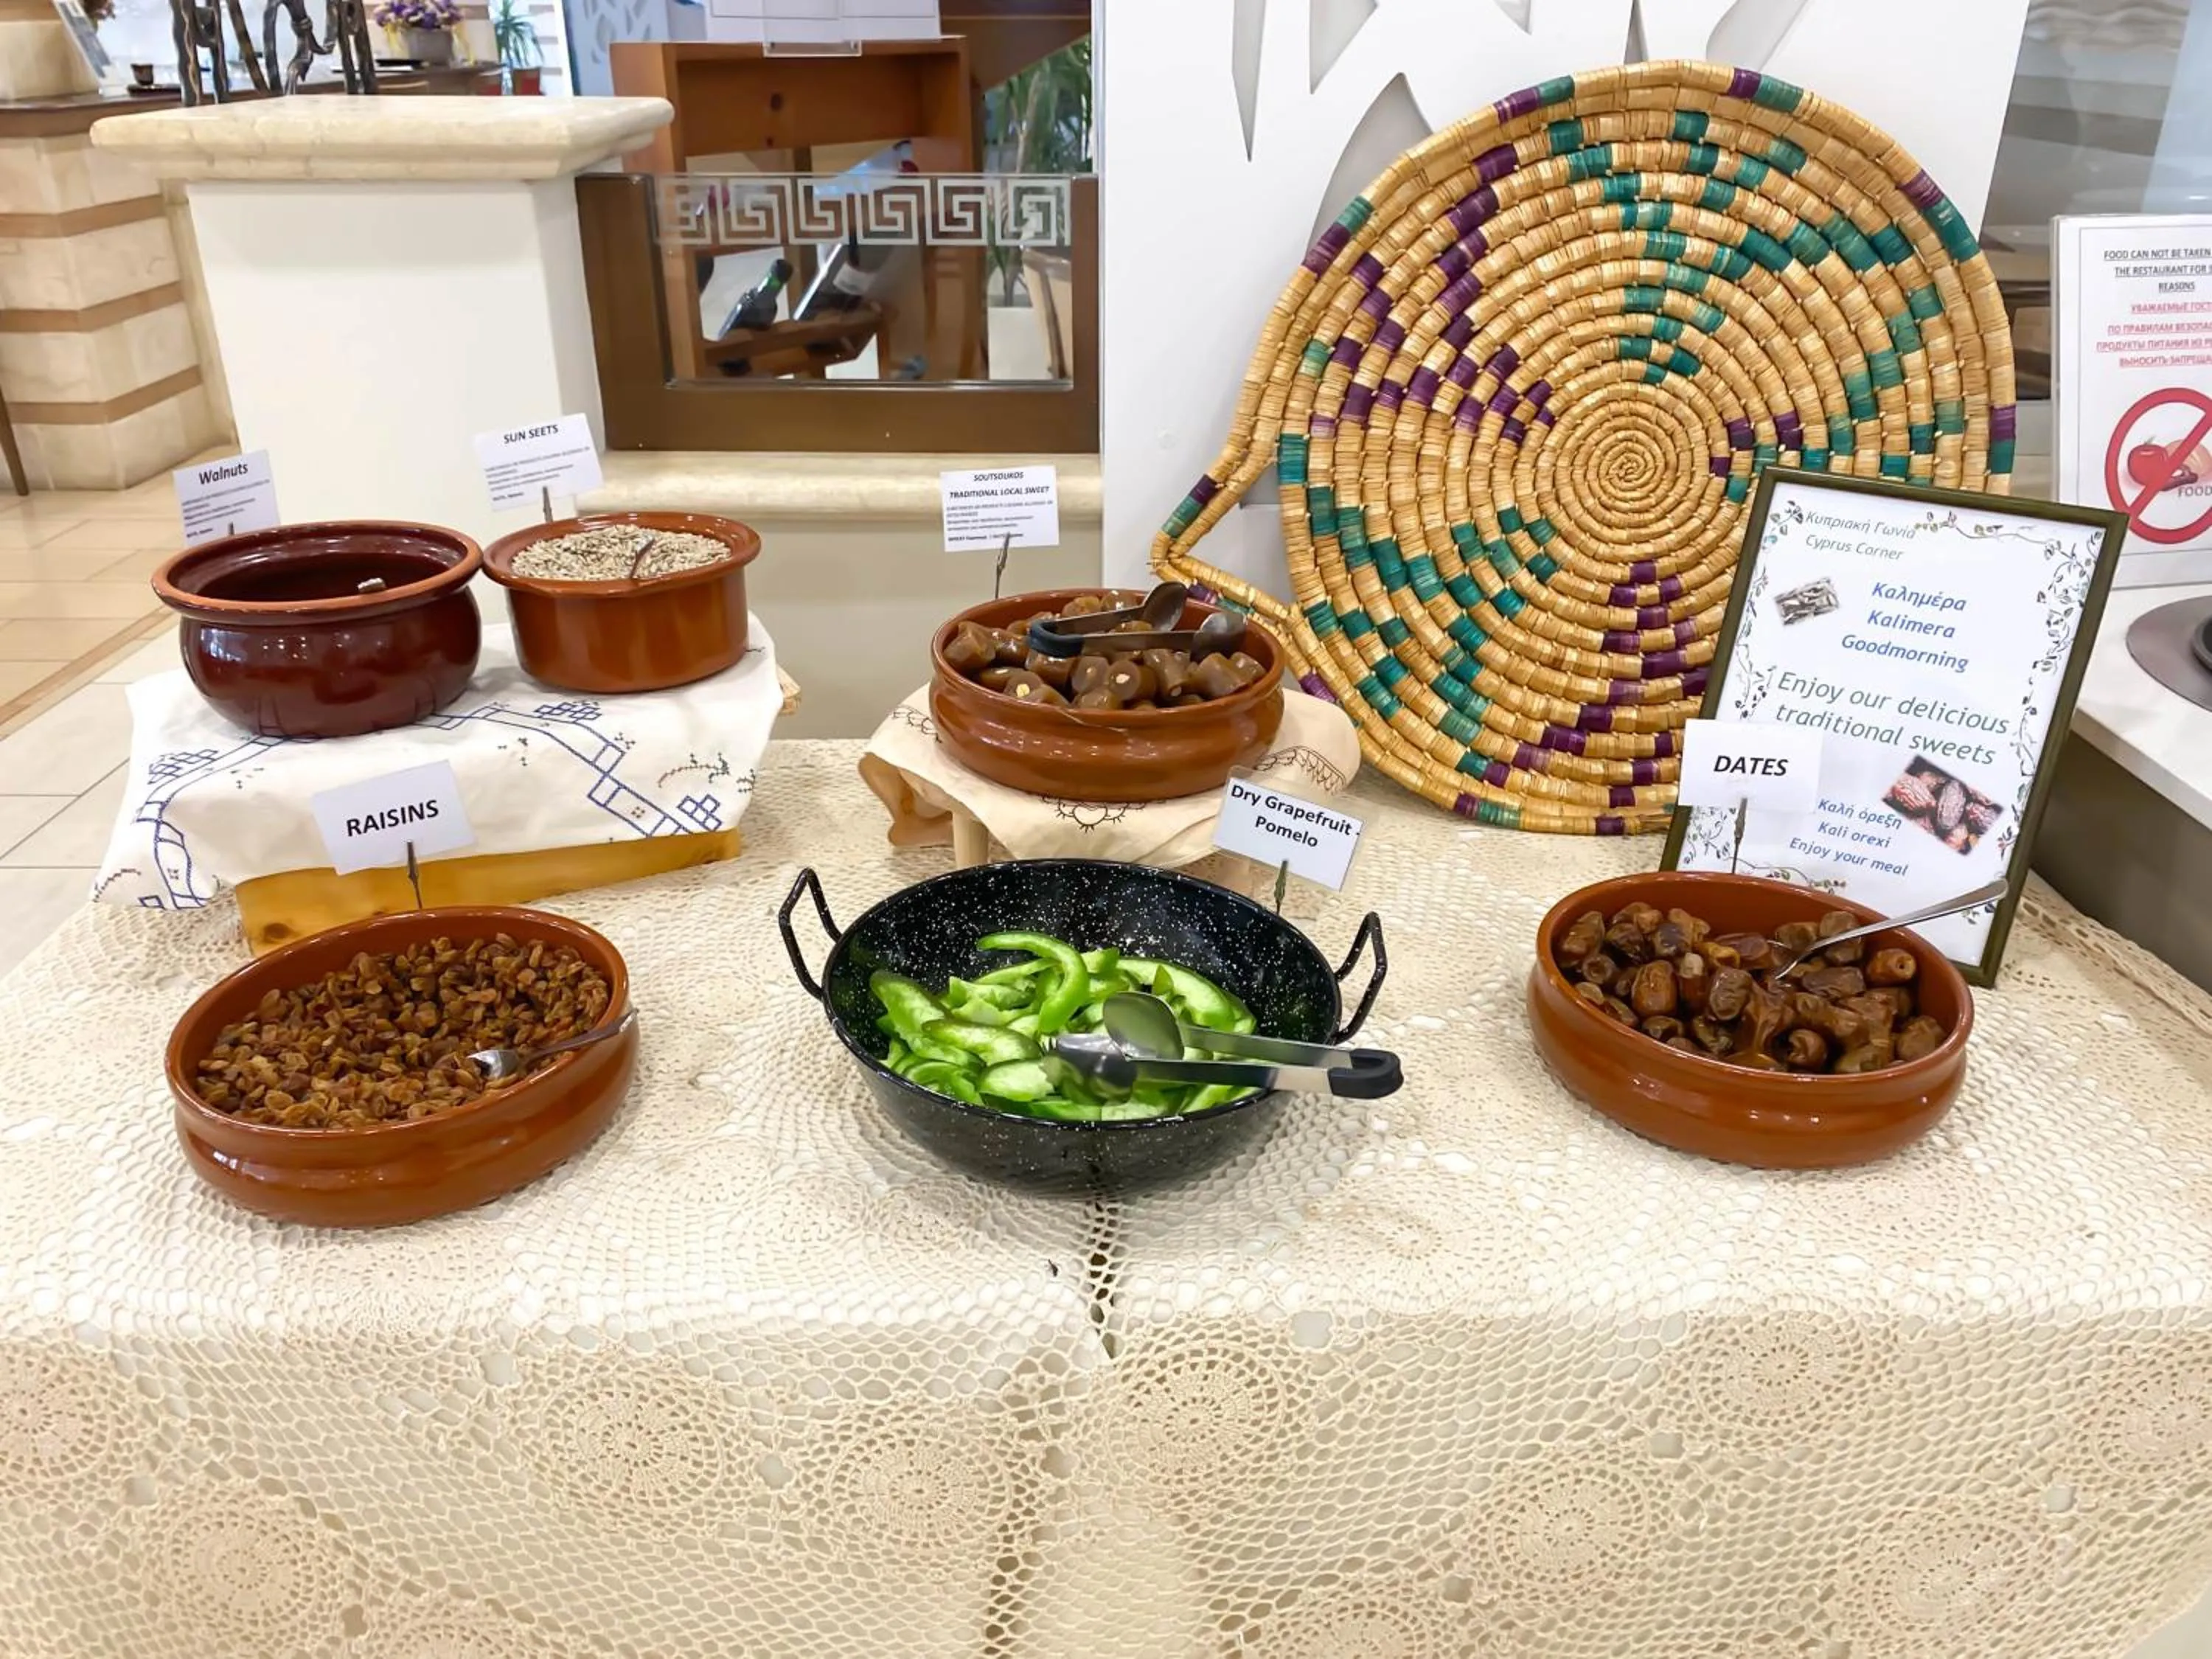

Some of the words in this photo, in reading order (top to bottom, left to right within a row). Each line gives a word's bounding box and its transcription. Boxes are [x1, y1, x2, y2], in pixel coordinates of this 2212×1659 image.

[2104, 250, 2129, 259] FOOD
[2130, 250, 2149, 259] CAN
[2151, 249, 2169, 258] NOT
[2171, 248, 2183, 257] BE
[2183, 248, 2211, 257] TAKEN
[2115, 266, 2130, 275] THE
[2132, 265, 2188, 274] RESTAURANT
[2190, 265, 2207, 274] FOR
[2158, 282, 2195, 291] REASONS
[503, 430, 526, 444] SUN
[529, 424, 559, 439] SEETS
[198, 464, 248, 485] Walnuts
[950, 488, 998, 498] TRADITIONAL
[1001, 487, 1023, 496] LOCAL
[1024, 485, 1050, 494] SWEET
[1806, 510, 1871, 533] Κυπριακή
[1806, 534, 1852, 552] Cyprus
[1855, 542, 1904, 560] Corner
[1871, 582, 1967, 612] Καλημέρα
[1867, 610, 1956, 639] Kalimera
[1841, 633, 1969, 673] Goodmorning
[1777, 671, 1846, 704] Enjoy
[1849, 689, 1893, 709] our
[1897, 696, 2011, 735] delicious
[1775, 703, 1905, 746] traditional
[1908, 734, 1997, 765] sweets
[1713, 754, 1789, 776] DATES
[346, 799, 439, 837] RAISINS
[1231, 785, 1262, 806] Dry
[1265, 796, 1352, 836] Grapefruit
[1818, 798, 1854, 818] Καλή
[1858, 808, 1902, 830] όρεξη
[1255, 815, 1318, 847] Pomelo
[1818, 821, 1849, 838] Kali
[1851, 831, 1892, 849] orexi
[1789, 837, 1833, 859] Enjoy
[1834, 849, 1868, 865] your
[1869, 858, 1910, 876] meal
